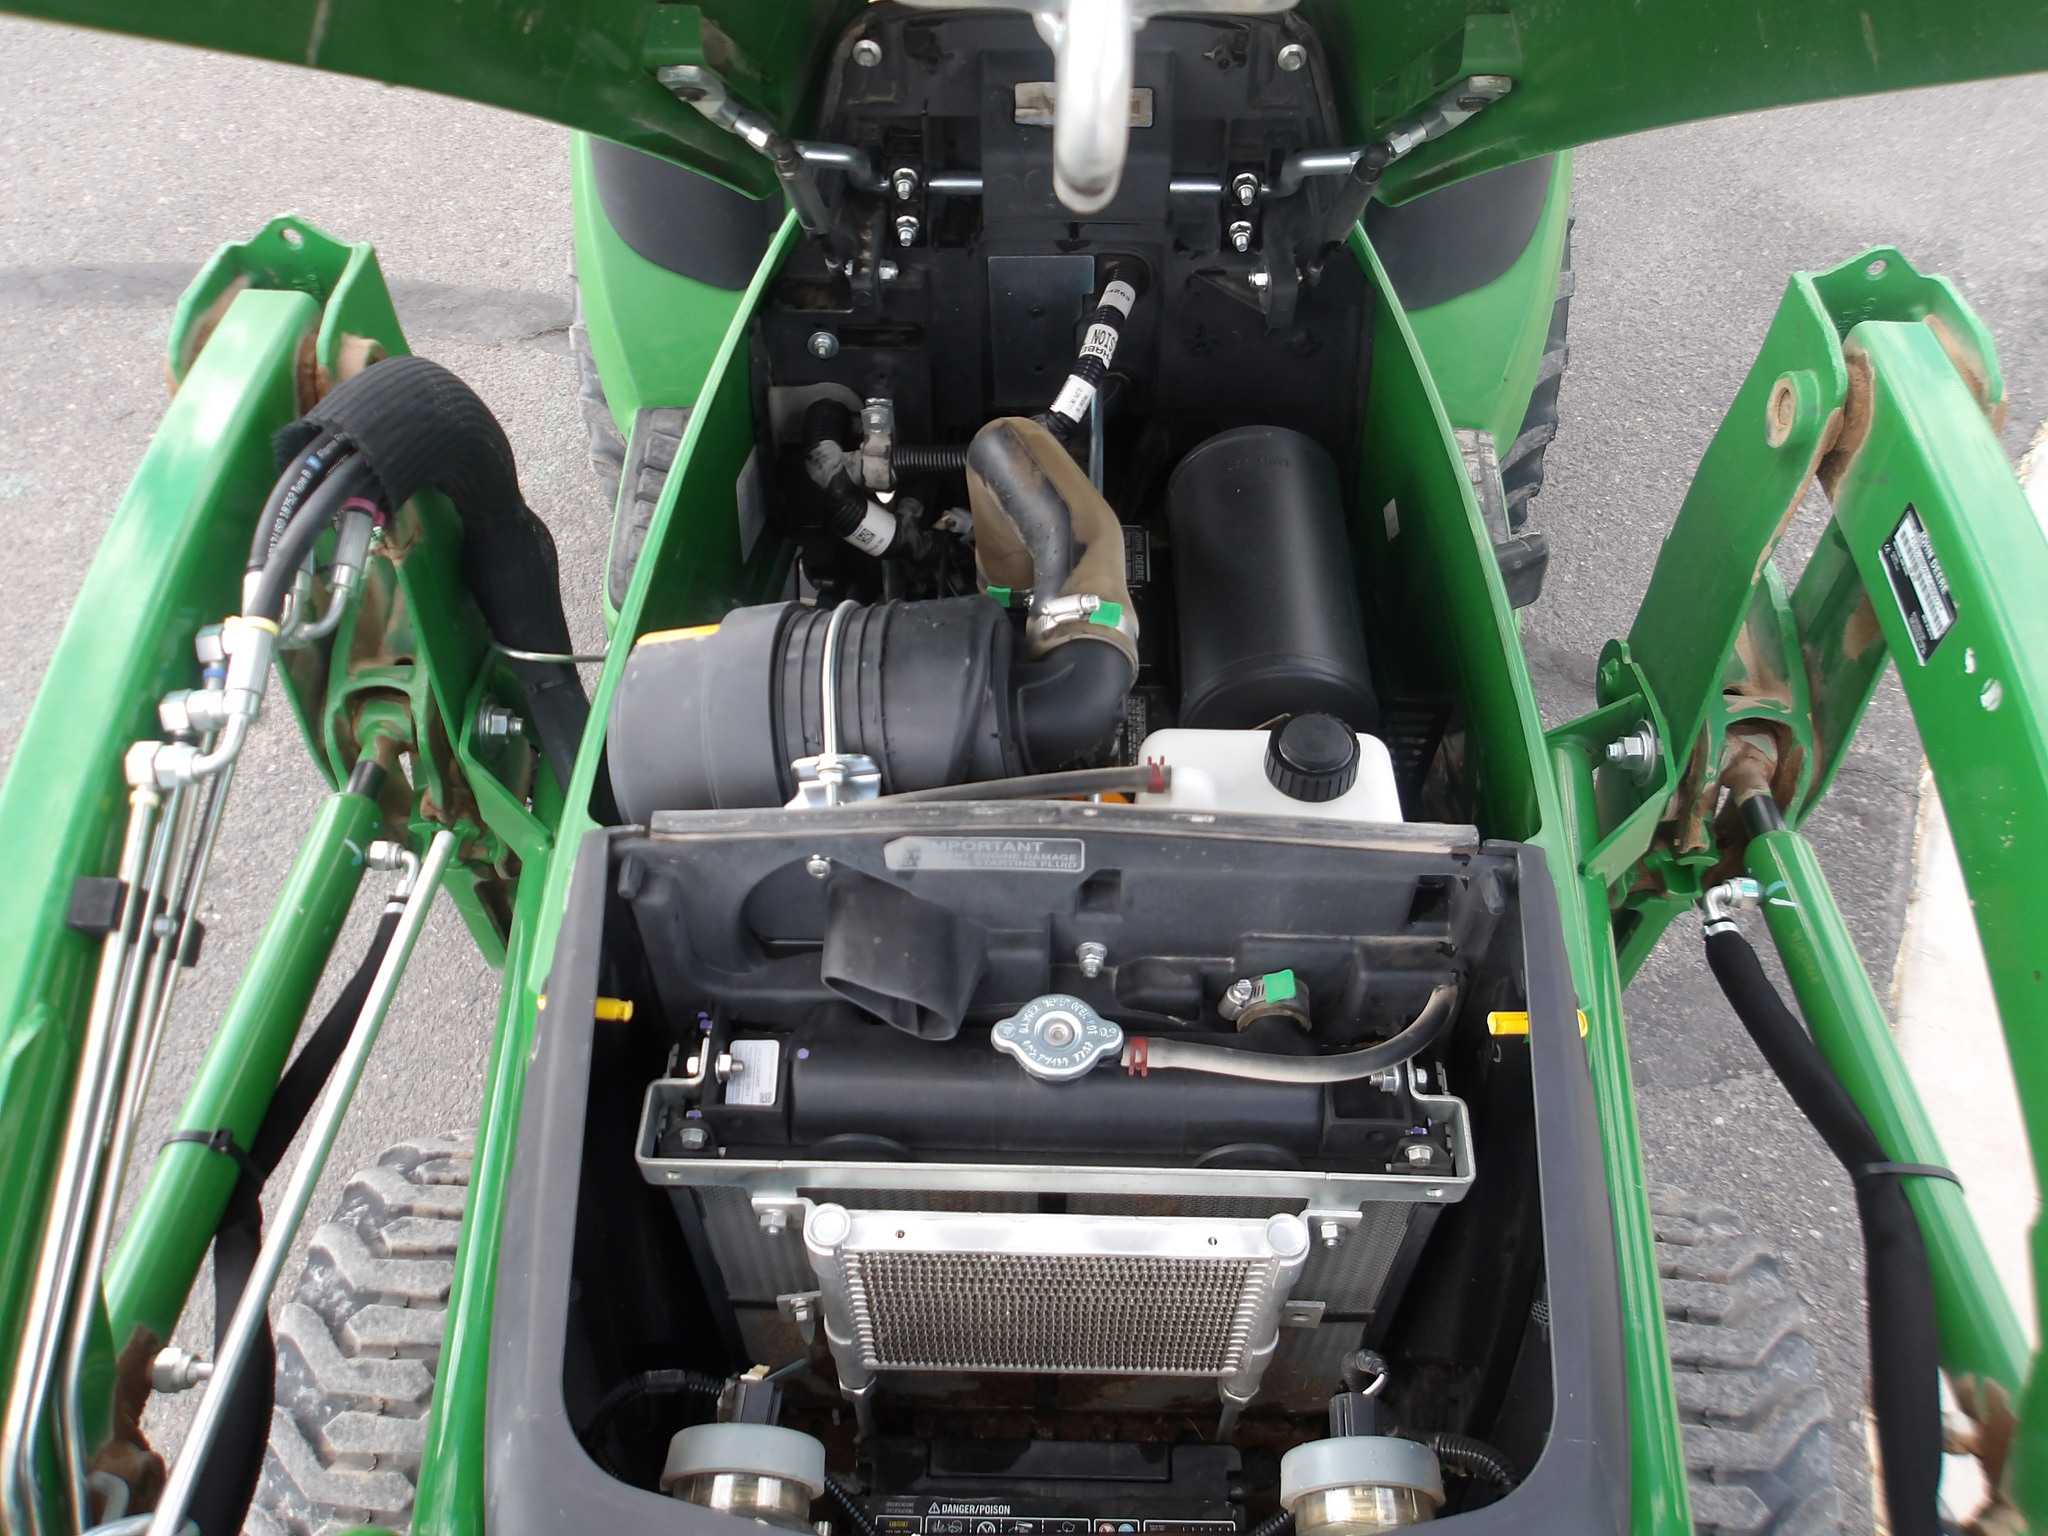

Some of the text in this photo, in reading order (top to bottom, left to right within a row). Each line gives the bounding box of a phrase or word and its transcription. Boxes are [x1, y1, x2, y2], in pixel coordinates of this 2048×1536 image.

[279, 491, 297, 518] 18752
[290, 477, 308, 494] Type
[1134, 530, 1144, 580] JOHN DEERE
[1920, 531, 1935, 559] JOHN
[1930, 557, 1949, 595] DEERE
[1024, 853, 1078, 861] DAMAGE
[941, 1503, 1011, 1515] DANGER/POISON
